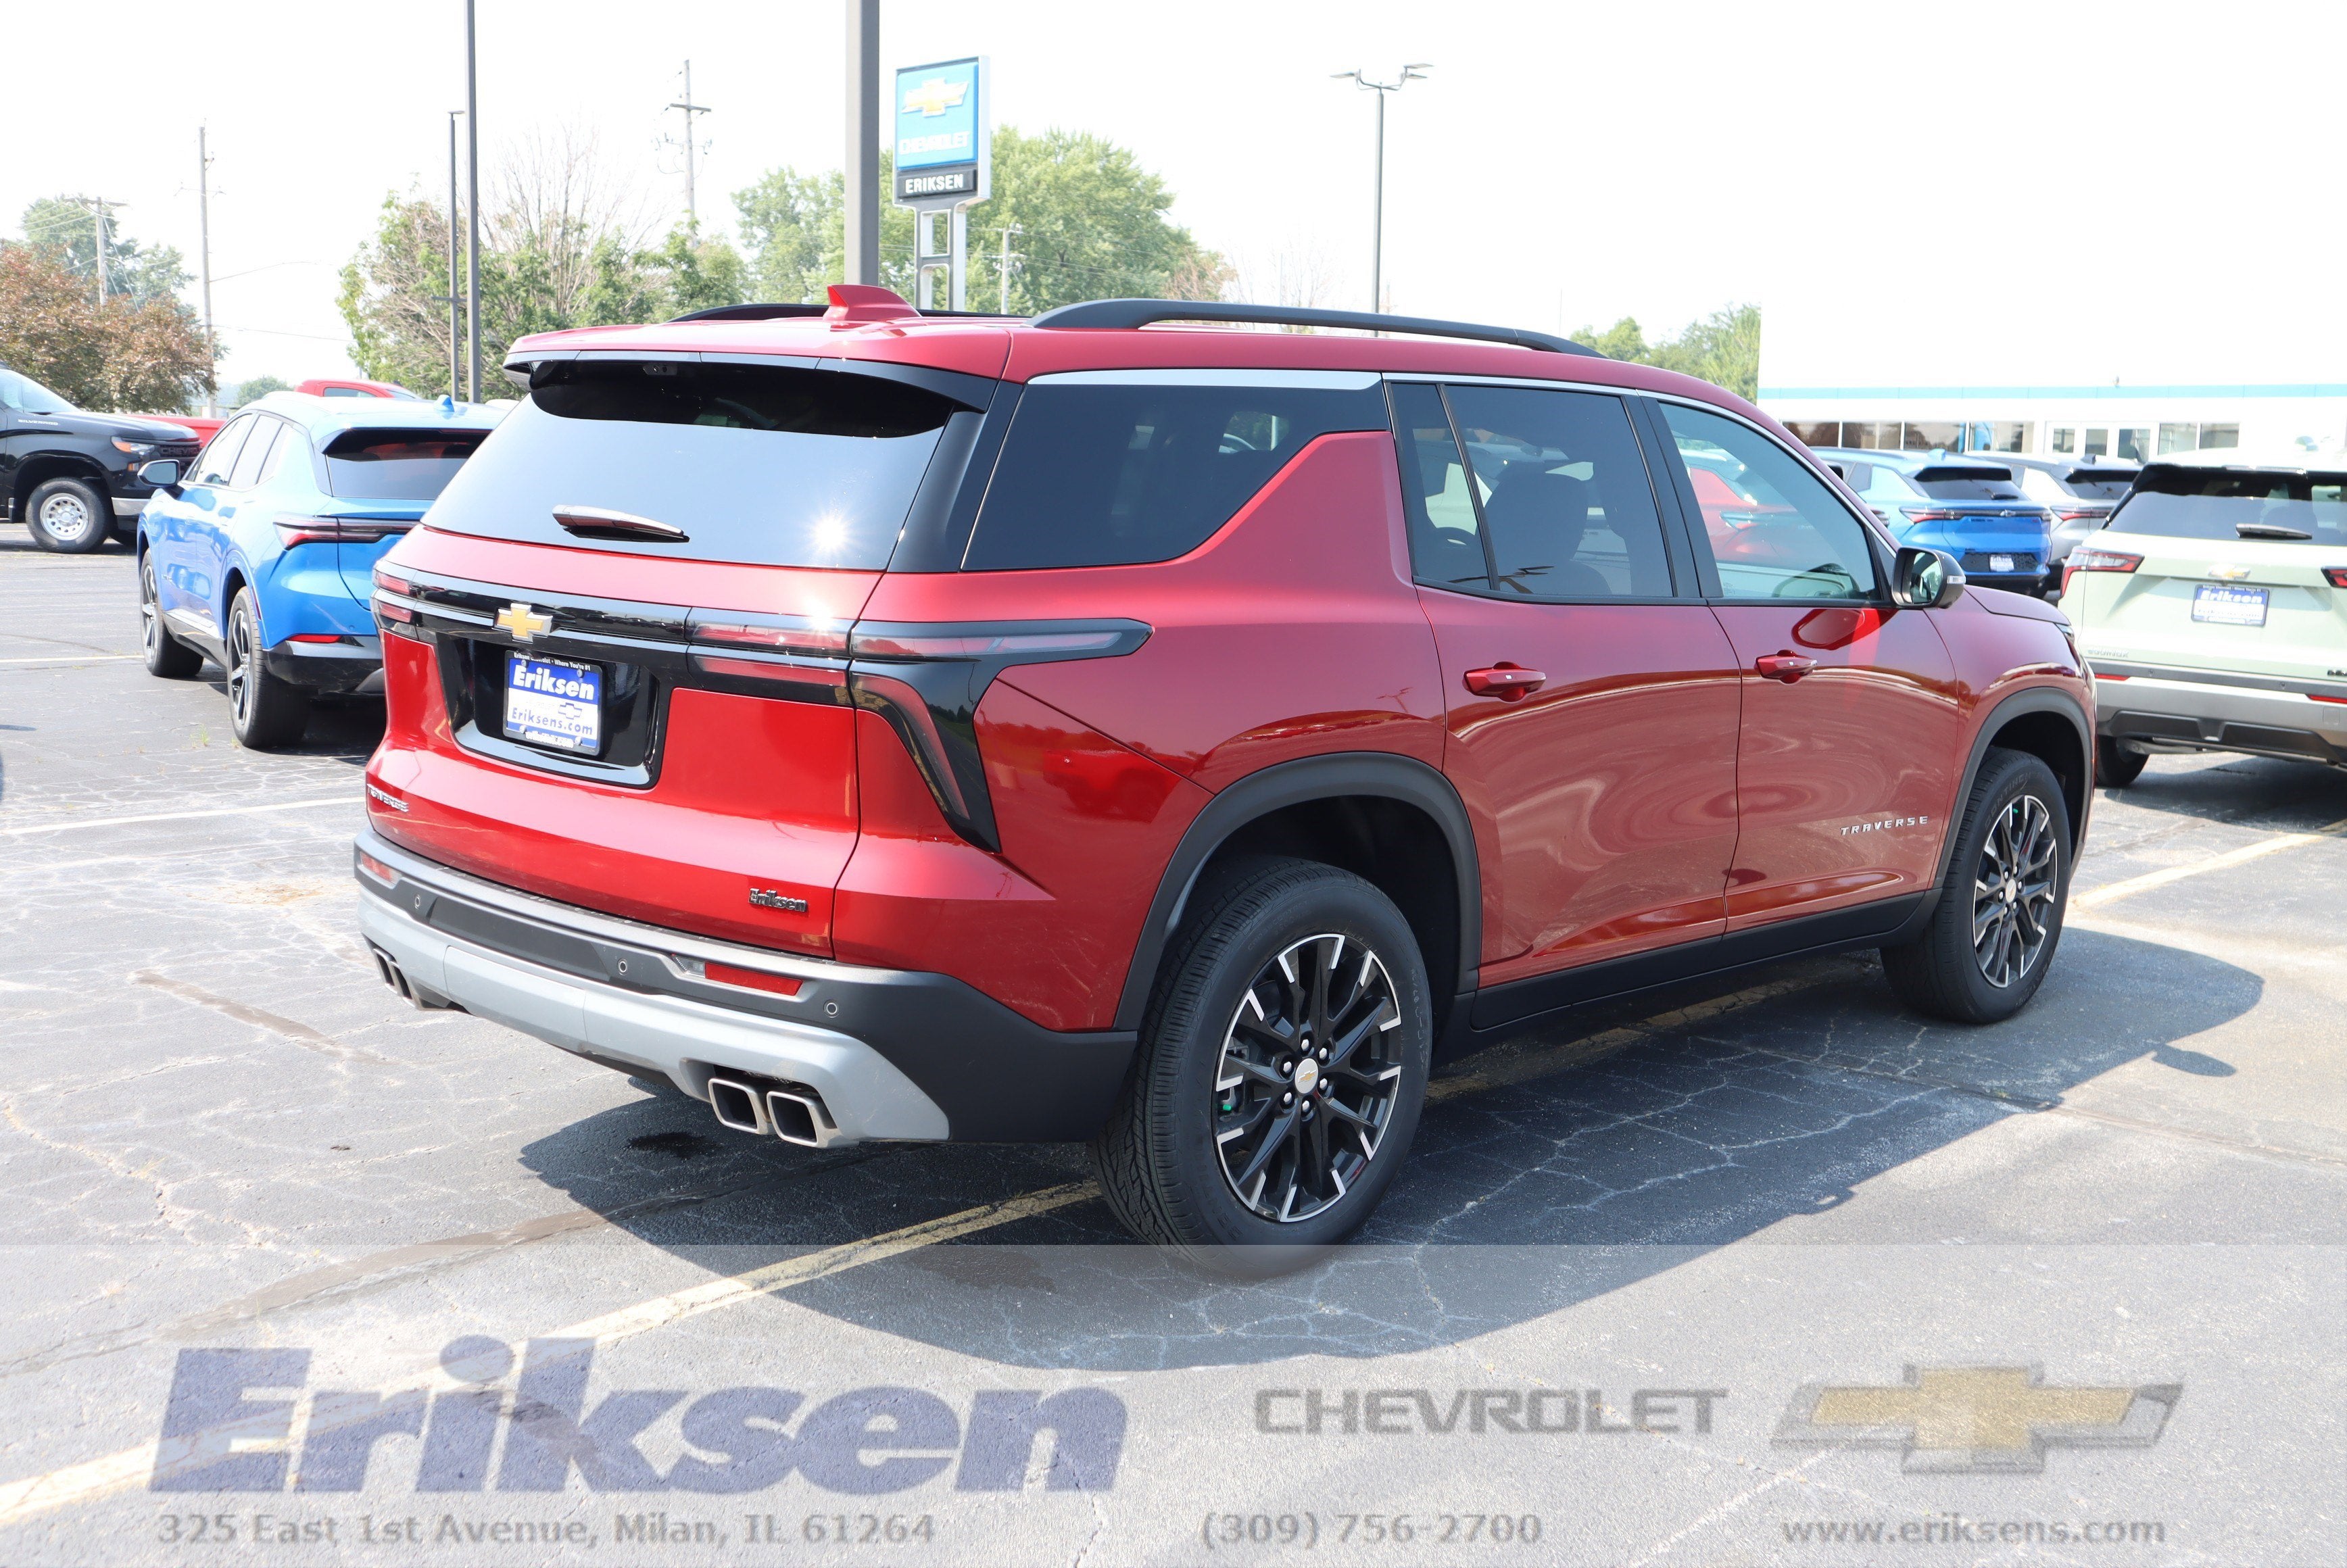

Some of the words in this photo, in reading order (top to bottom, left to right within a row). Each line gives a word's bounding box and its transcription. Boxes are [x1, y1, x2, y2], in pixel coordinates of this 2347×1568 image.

[905, 174, 963, 193] ERIKSEN
[514, 652, 530, 661] Eriksen
[554, 659, 569, 667] Where
[569, 662, 584, 670] You're
[513, 664, 595, 700] Eriksen
[512, 707, 592, 735] Eriksens.com
[1840, 816, 1929, 836] TRAVERSE
[748, 887, 808, 912] Eriksen
